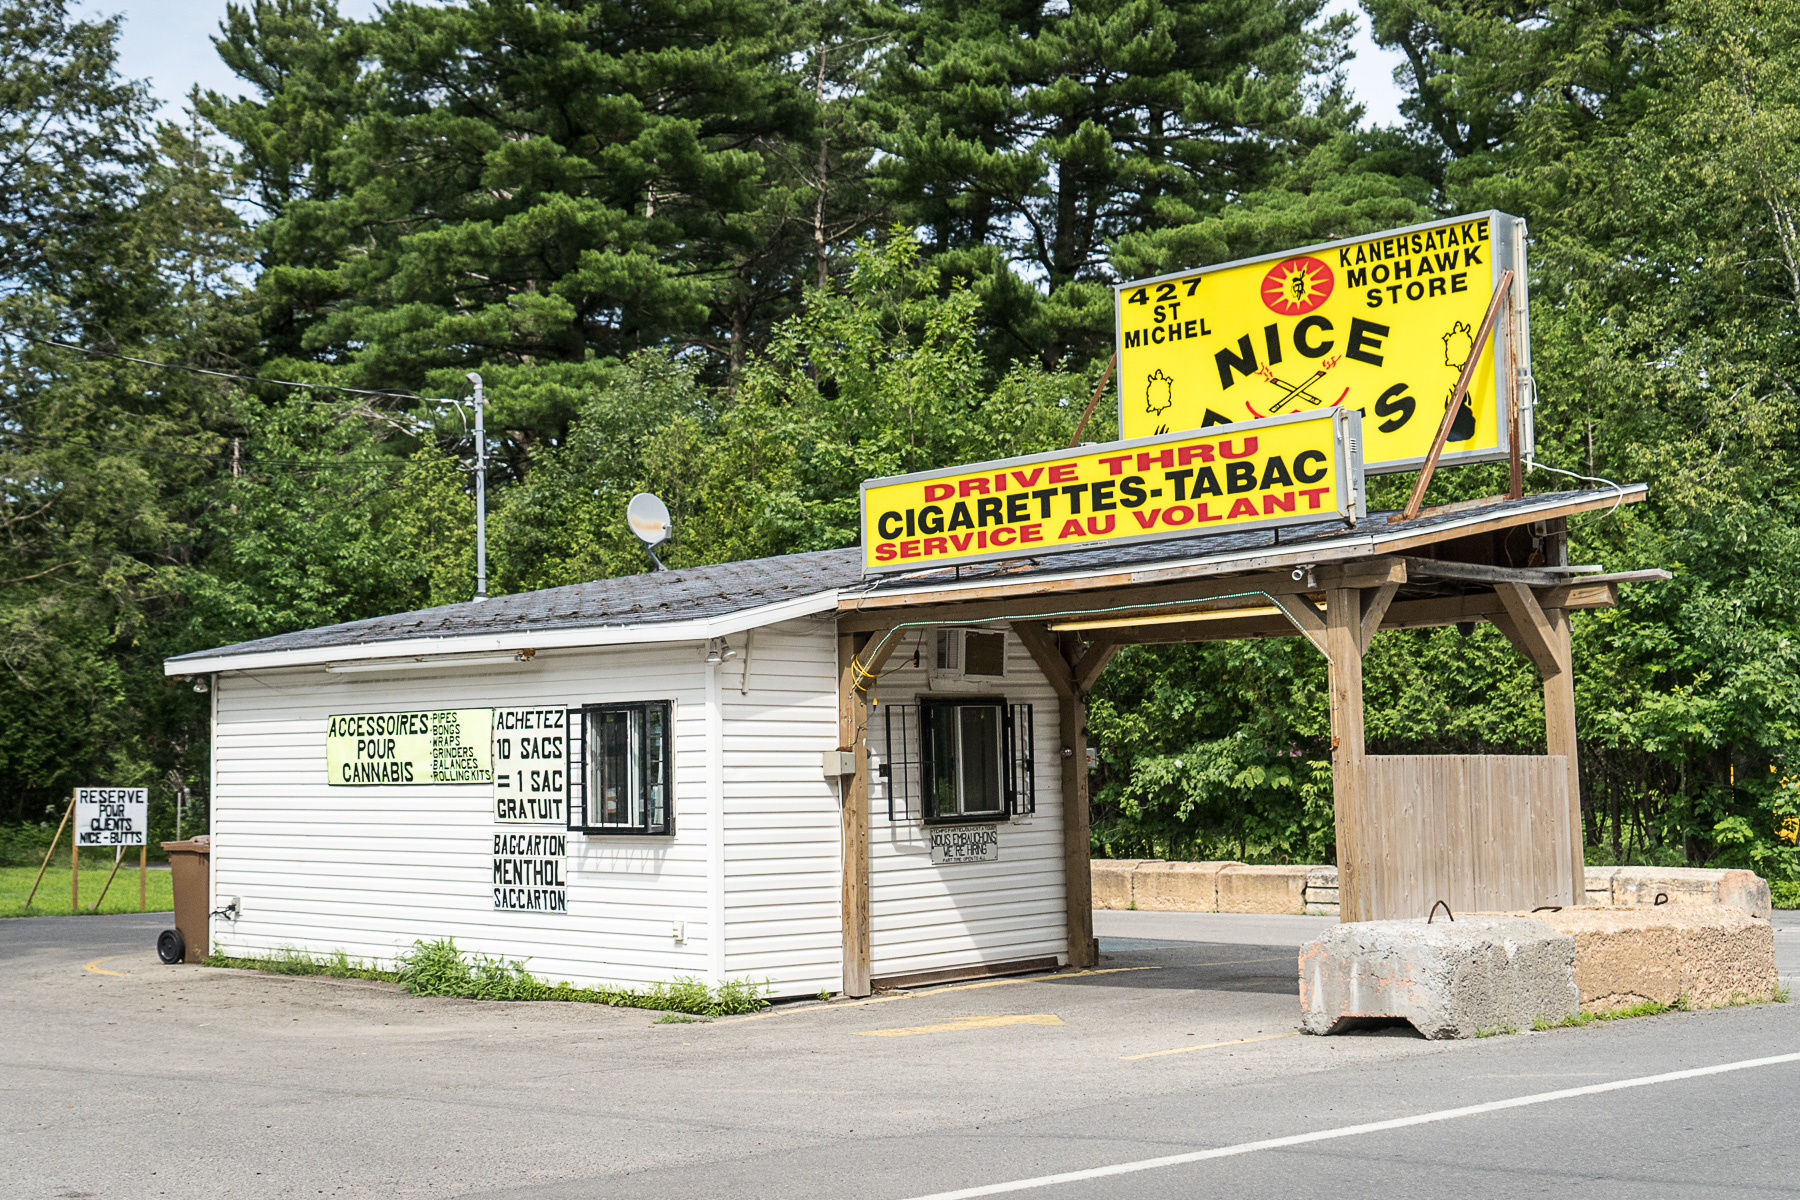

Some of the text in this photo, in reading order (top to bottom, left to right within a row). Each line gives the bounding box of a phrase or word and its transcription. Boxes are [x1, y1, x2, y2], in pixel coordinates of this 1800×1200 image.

[1340, 221, 1489, 267] KANEHSATAKE
[1347, 245, 1482, 288] MOHAWK
[1128, 277, 1202, 305] 427
[1367, 272, 1468, 308] STORE
[1154, 302, 1181, 323] ST
[1125, 318, 1212, 349] MICHEL
[1214, 315, 1390, 391] NICE
[925, 436, 1259, 503] DRIVE THRU
[878, 450, 1328, 540] CIGARETTES-TABAC
[875, 487, 1330, 561] SERVICE AU VOLANT
[328, 713, 429, 738] ACCESSOIRES
[433, 712, 457, 723] PIPES
[497, 710, 564, 730] ACHETEZ
[433, 724, 461, 736] BONGS
[358, 739, 396, 759] POUR
[433, 736, 461, 747] WRAPS
[497, 736, 563, 760] 10 SACS
[433, 747, 474, 758] GRINDERS
[342, 761, 414, 782] CANNABIS
[433, 758, 478, 770] BALANCES
[517, 770, 523, 792] 1
[531, 770, 562, 792] SAC
[80, 790, 144, 804] RESERVE
[99, 804, 125, 817] POUR
[497, 799, 563, 819] GRATUIT
[91, 818, 132, 831] CLIENTS
[932, 831, 997, 846] NOUS EMBAUCHONS
[494, 859, 565, 886] MENTHOL
